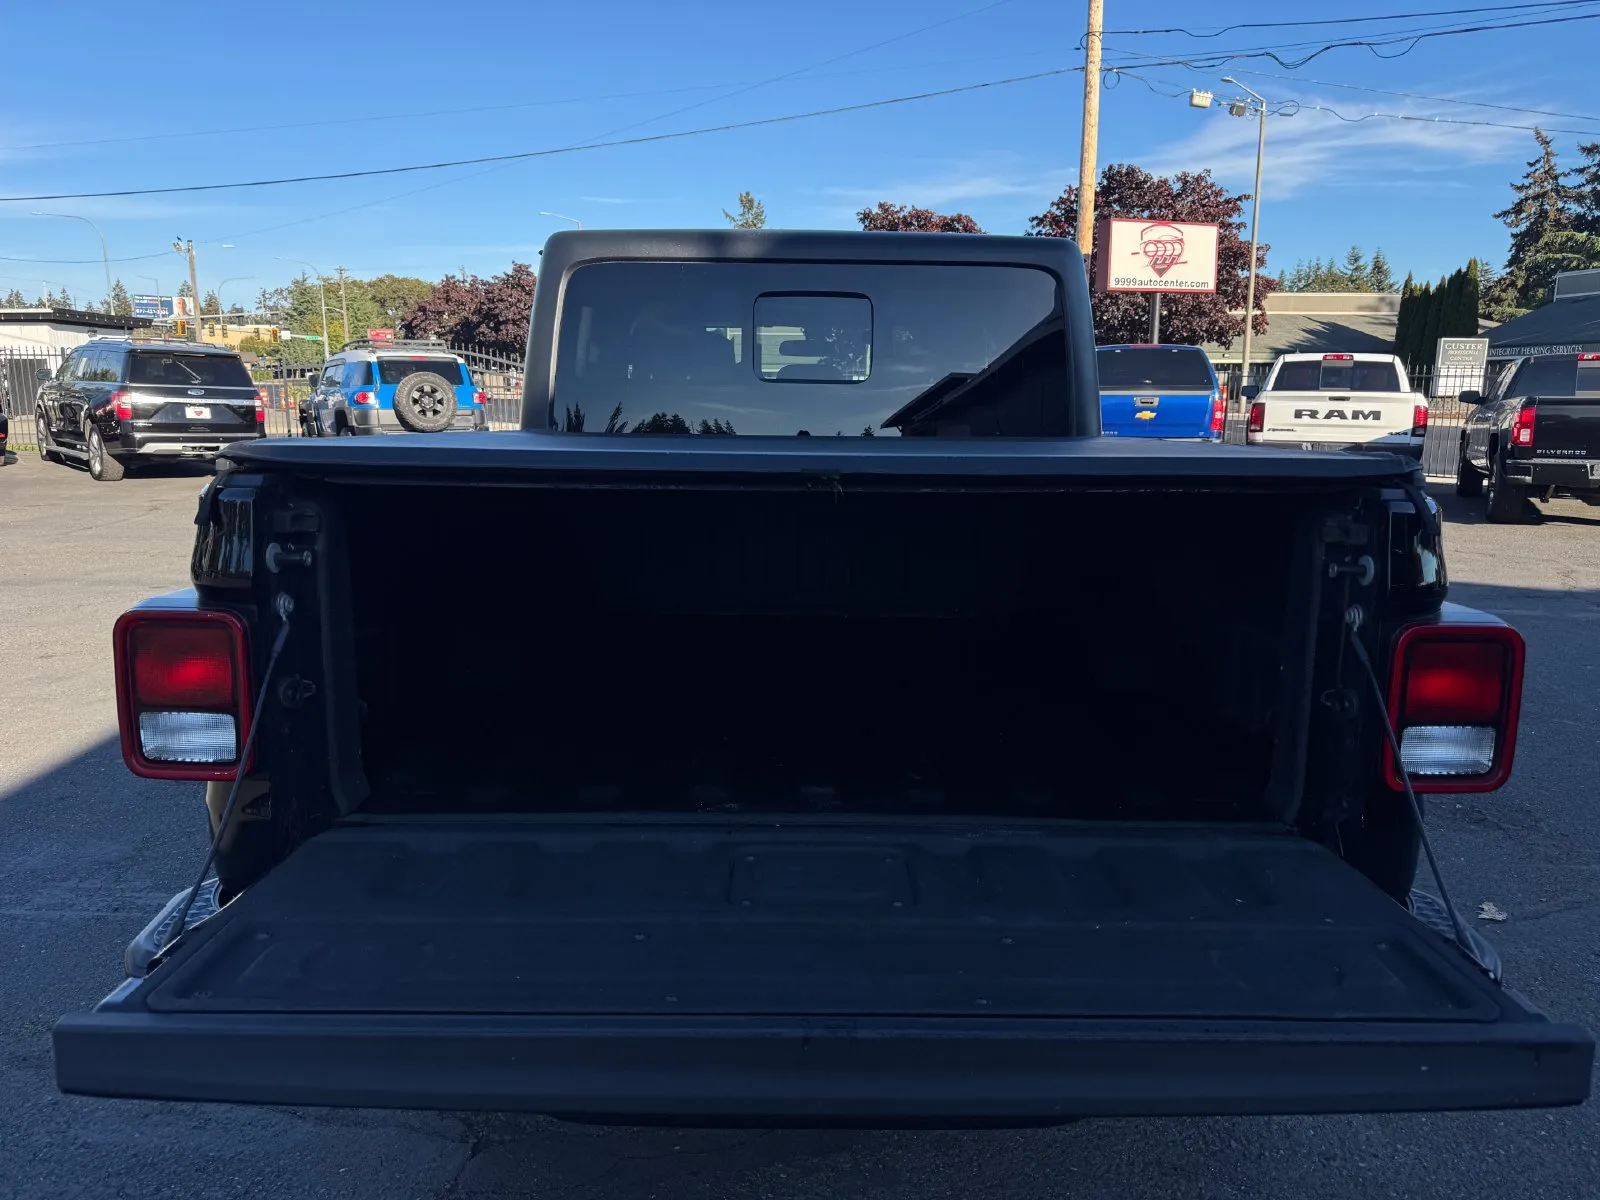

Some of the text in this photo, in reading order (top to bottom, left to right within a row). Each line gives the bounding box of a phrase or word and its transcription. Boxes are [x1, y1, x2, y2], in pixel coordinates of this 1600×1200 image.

[1113, 277, 1209, 289] 9999autocenter.com
[1489, 344, 1583, 356] INTEGRITY HEARING SERVICES
[1294, 408, 1382, 421] RAM
